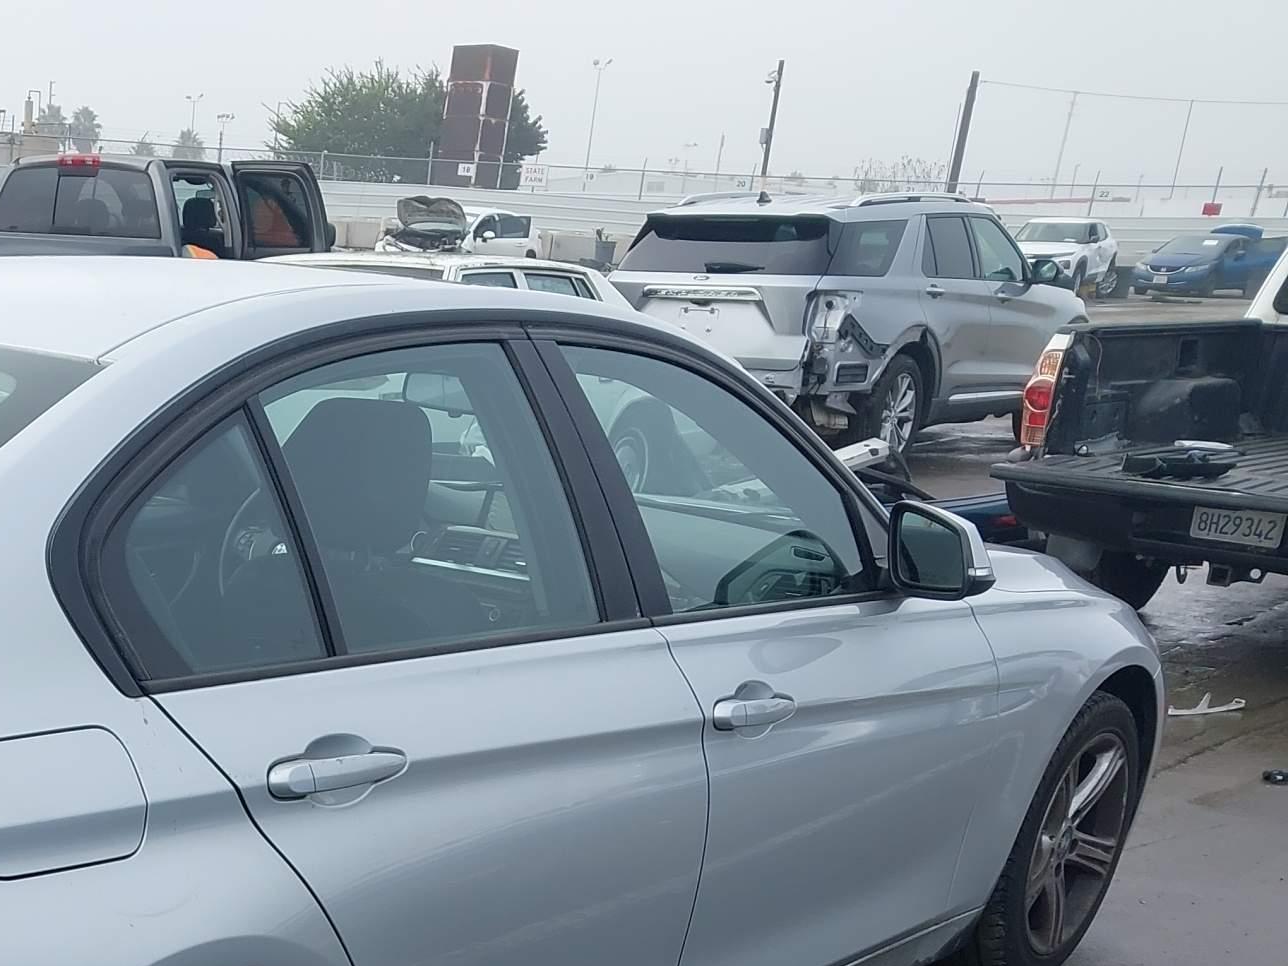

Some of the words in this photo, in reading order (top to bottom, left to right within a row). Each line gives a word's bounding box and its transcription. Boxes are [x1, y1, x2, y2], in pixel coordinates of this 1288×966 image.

[525, 167, 545, 175] STATE
[524, 175, 543, 183] FARM
[1099, 190, 1110, 198] 22
[1198, 512, 1278, 540] 8H29342
